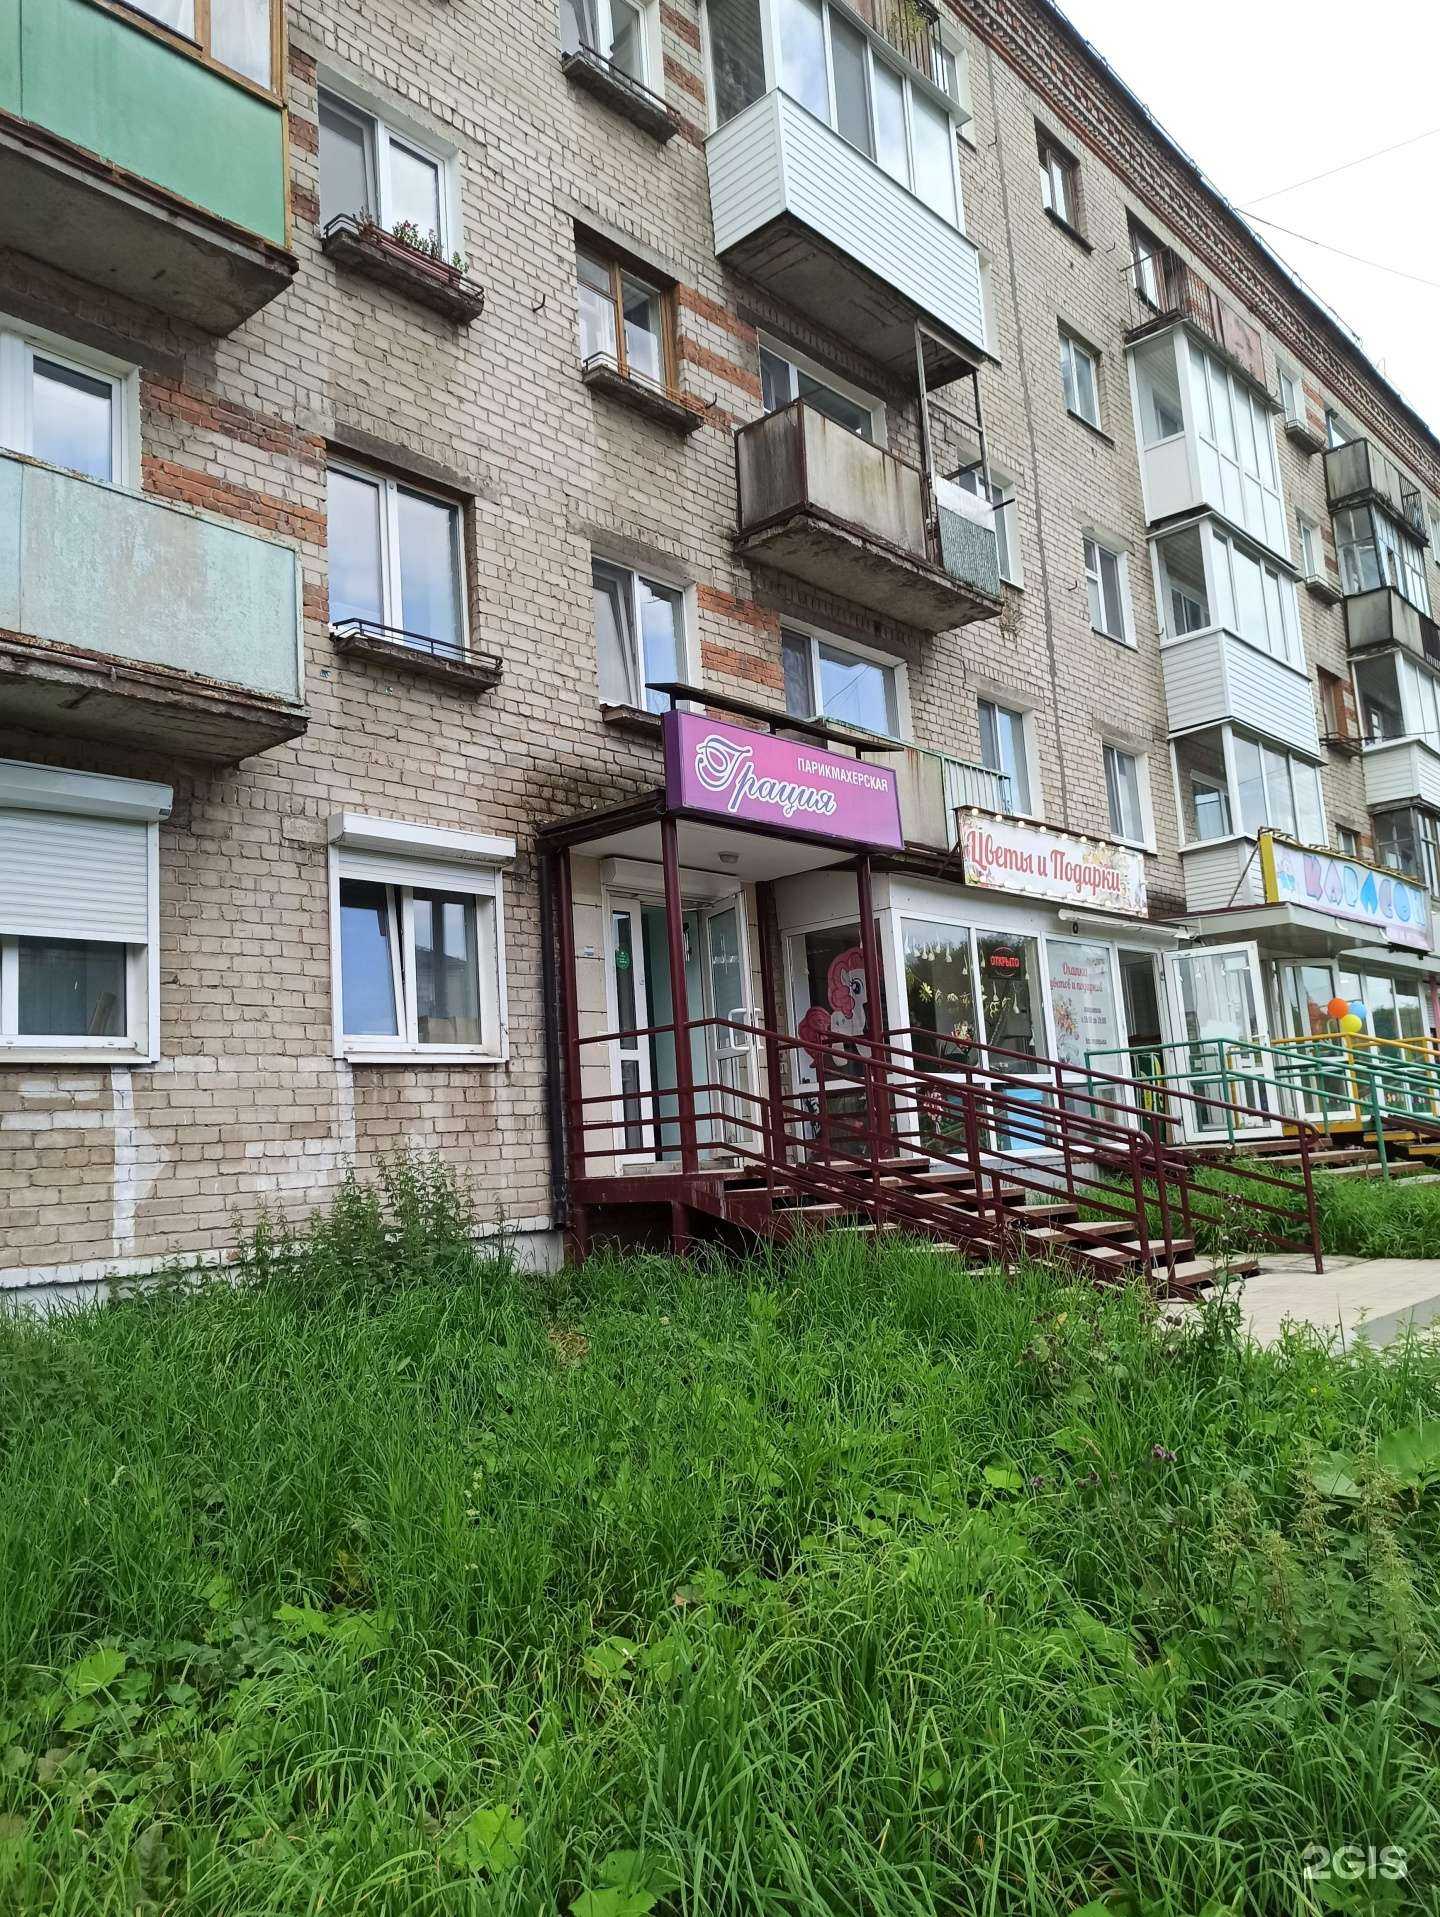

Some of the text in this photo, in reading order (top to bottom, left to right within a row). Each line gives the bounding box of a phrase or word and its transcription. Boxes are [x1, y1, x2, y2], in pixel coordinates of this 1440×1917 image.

[695, 735, 837, 817] Грация
[797, 757, 889, 793] ПАРИКМАХЕРСКАЯ
[967, 830, 1122, 896] Цветы и Подарки
[990, 955, 1020, 968] ОТКРЫТО
